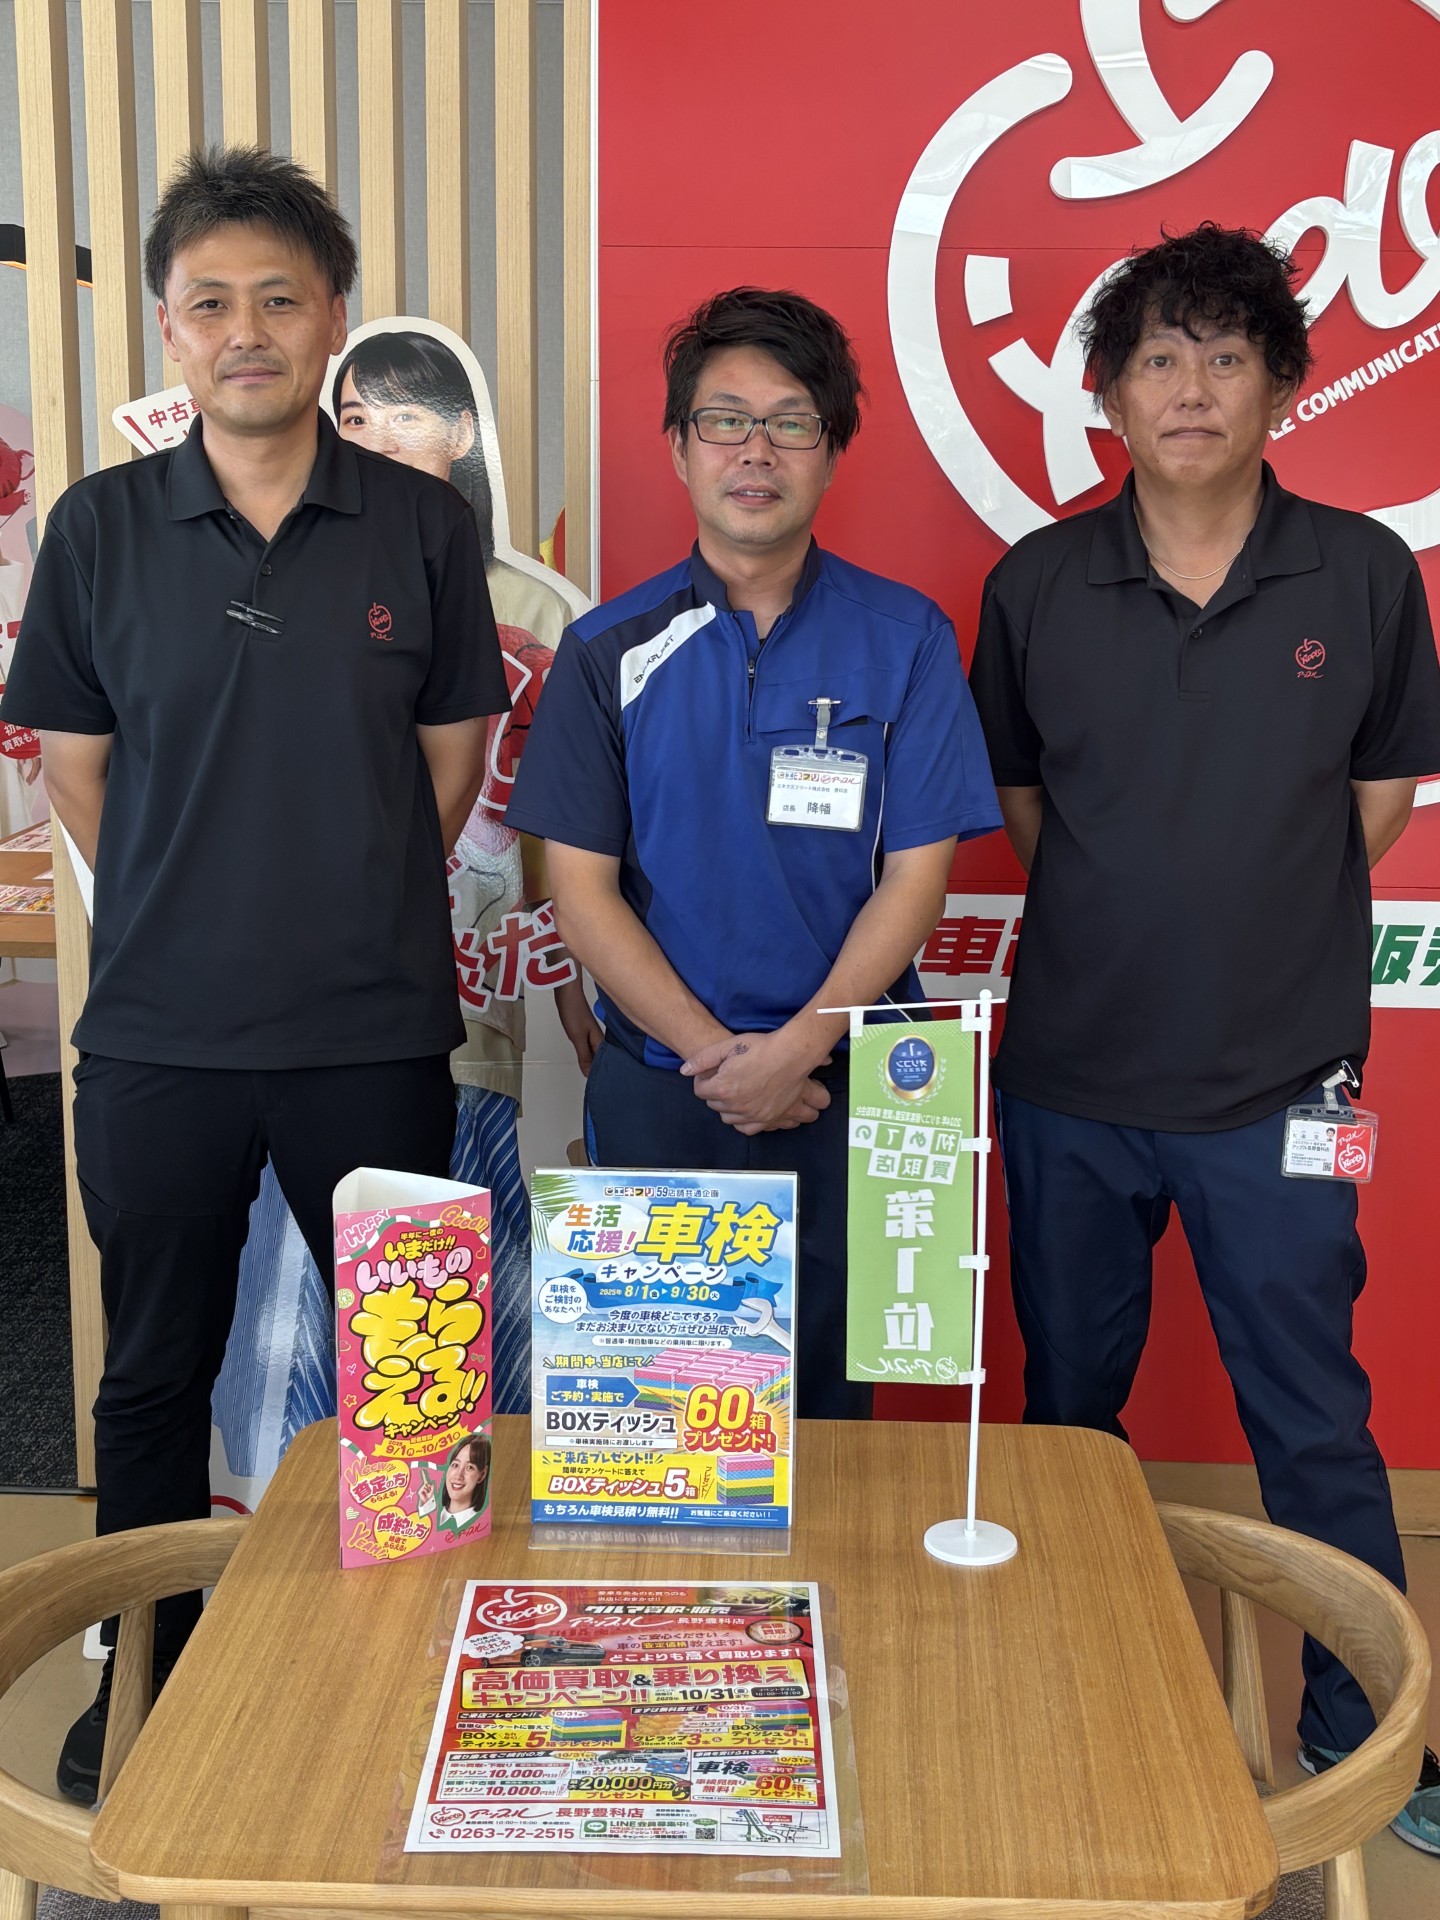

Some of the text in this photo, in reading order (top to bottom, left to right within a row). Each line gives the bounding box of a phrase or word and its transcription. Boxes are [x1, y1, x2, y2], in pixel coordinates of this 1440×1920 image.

[1296, 322, 1440, 422] COMMUNICAT
[782, 804, 796, 812] 店長
[656, 1186, 719, 1198] 59店舗共通企画
[440, 1205, 489, 1233] Good!!
[565, 1203, 622, 1228] 生活
[344, 1208, 391, 1248] HAPPY
[636, 1201, 782, 1266] 車検
[384, 1235, 456, 1261] いまだけ!!
[567, 1228, 637, 1254] 応援!
[355, 1246, 473, 1294] いいもの
[600, 1263, 724, 1281] キャンペーン
[549, 1284, 577, 1294] 車検を
[544, 1294, 582, 1305] ご検討の
[544, 1305, 582, 1314] あなたへ!!
[609, 1309, 719, 1322] 今度の車検どこでする?
[575, 1322, 747, 1336] まだお決まりでない方はぜひ当店で!!
[555, 1355, 644, 1368] 期間中、当店にて
[575, 1378, 600, 1390] 車検
[551, 1390, 625, 1403] ご予約・実施で
[383, 1412, 460, 1439] キャンペーン
[545, 1411, 677, 1434] BOXティッシュ
[684, 1430, 774, 1450] プレゼント!
[552, 1451, 654, 1465] ご来店プレゼント!!
[562, 1466, 646, 1476] 簡単なアンケートに答えて
[543, 1503, 679, 1519] もちろん車検見積り無料!!
[346, 1522, 390, 1560] YEAH!!
[677, 1617, 745, 1625] 長野豊科店
[609, 1647, 801, 1663] どこよりも高く買取ります!
[471, 1663, 796, 1692] 高価買取&乗り換え
[470, 1688, 648, 1707] キャンペーン!!
[462, 1732, 497, 1740] BOX
[731, 1737, 809, 1746] プレゼント!
[461, 1740, 522, 1748] ティッシュ
[692, 1760, 751, 1775] 車検
[586, 1791, 657, 1799] プレゼント!
[749, 1789, 812, 1798] プレゼント!
[555, 1807, 645, 1819] 長野豊科店
[450, 1827, 575, 1839] 0263-72-2515
